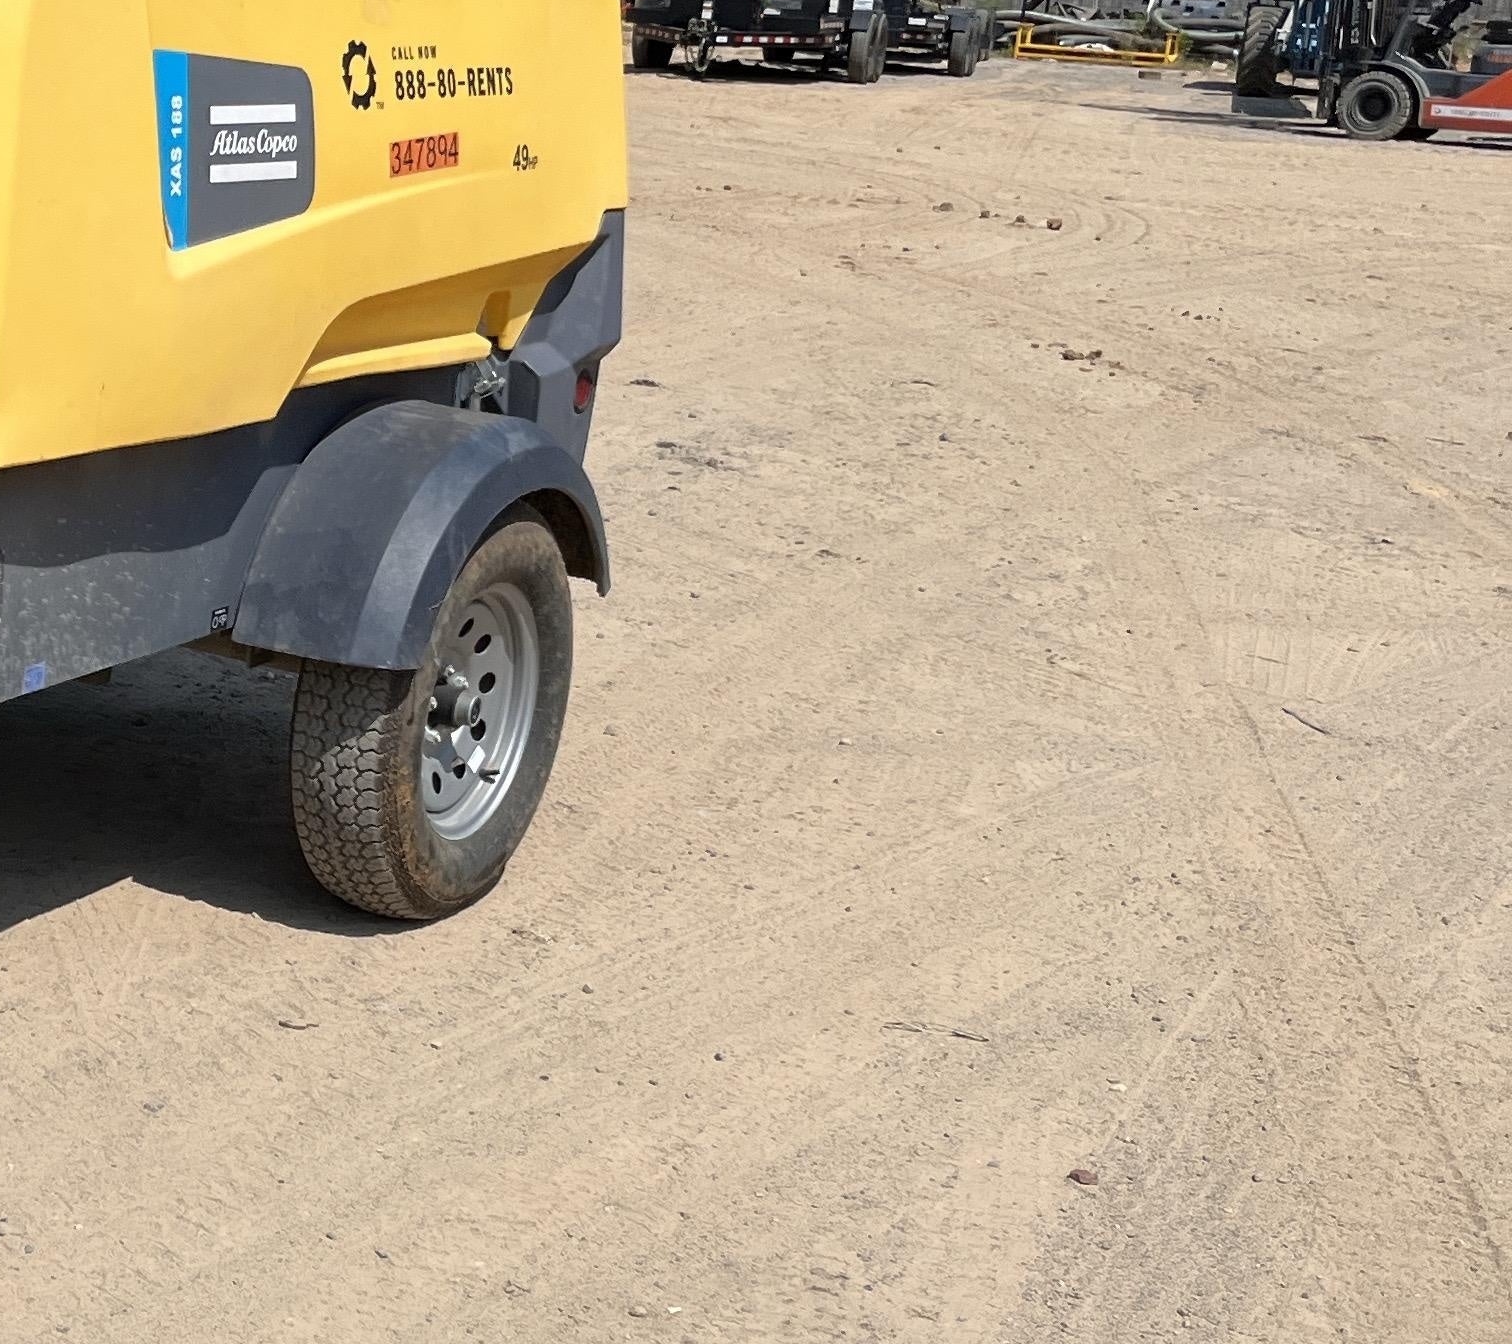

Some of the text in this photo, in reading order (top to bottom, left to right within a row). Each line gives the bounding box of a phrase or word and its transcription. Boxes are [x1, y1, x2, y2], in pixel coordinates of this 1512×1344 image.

[391, 45, 437, 60] CALL NOW
[394, 67, 513, 101] 888-80-RENTS
[170, 95, 183, 197] XAS 188
[391, 132, 459, 175] 347894
